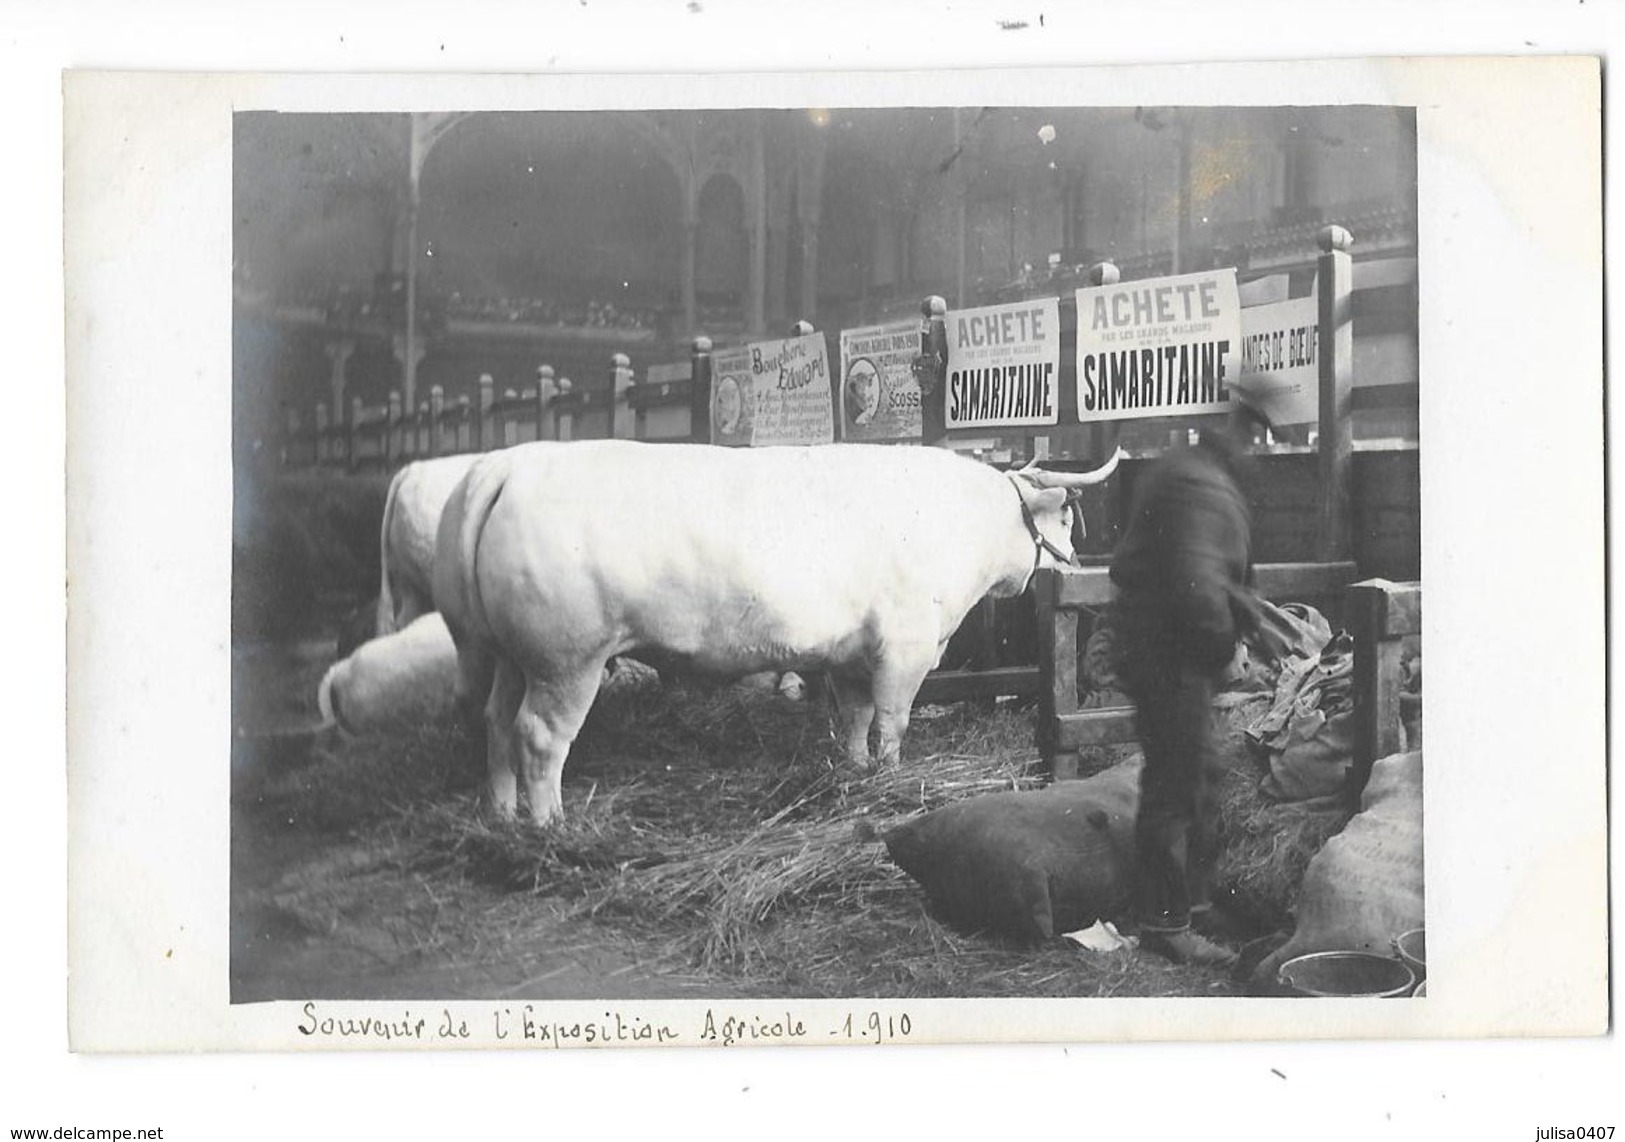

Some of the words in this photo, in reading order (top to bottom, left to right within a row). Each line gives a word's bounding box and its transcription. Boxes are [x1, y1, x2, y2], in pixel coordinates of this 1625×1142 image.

[951, 362, 1053, 421] SAMARITAINE
[1084, 340, 1230, 411] SAMARITAINE
[298, 1002, 426, 1041] Souvenir
[439, 1009, 471, 1039] de
[700, 1009, 808, 1047] Agricole
